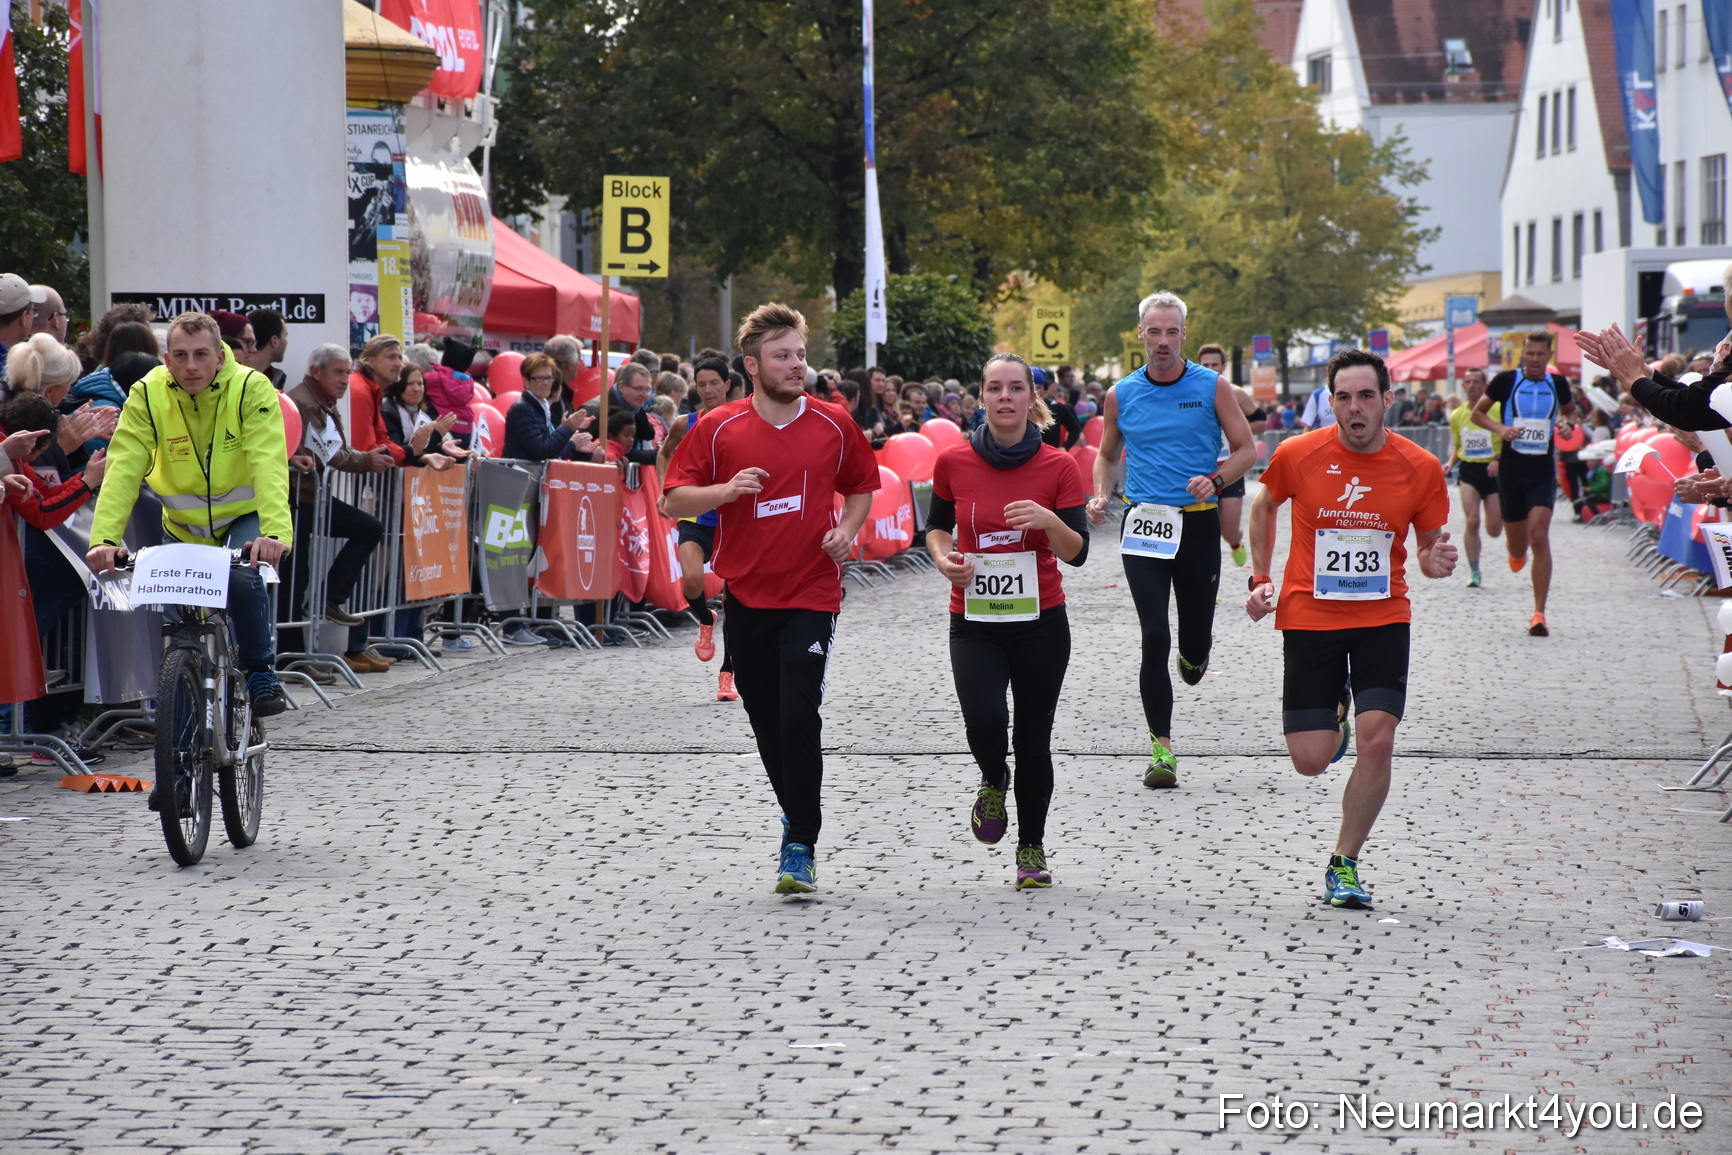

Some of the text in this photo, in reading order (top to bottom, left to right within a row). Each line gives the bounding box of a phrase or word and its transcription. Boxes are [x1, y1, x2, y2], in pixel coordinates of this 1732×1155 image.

[611, 180, 662, 199] Block
[620, 206, 653, 254] B
[380, 256, 401, 275] 18.
[1037, 308, 1065, 319] Block
[1041, 323, 1060, 350] C
[483, 340, 500, 349] AVIA
[1130, 351, 1144, 370] D
[1178, 401, 1203, 409] THULE
[1518, 429, 1545, 441] 2706
[1465, 438, 1488, 449] 2058
[768, 501, 790, 512] DEHN
[1317, 507, 1381, 521] funrunners
[1132, 518, 1174, 540] 2648
[1335, 518, 1389, 530] neumarkt
[990, 534, 1011, 542] DEHN
[1326, 550, 1380, 573] 2133
[150, 568, 212, 580] Erste Frau
[975, 573, 1024, 596] 5021
[1338, 579, 1368, 588] Michael
[137, 584, 222, 597] Halbmarathon
[989, 602, 1014, 611] Melina
[205, 699, 214, 729] FOX
